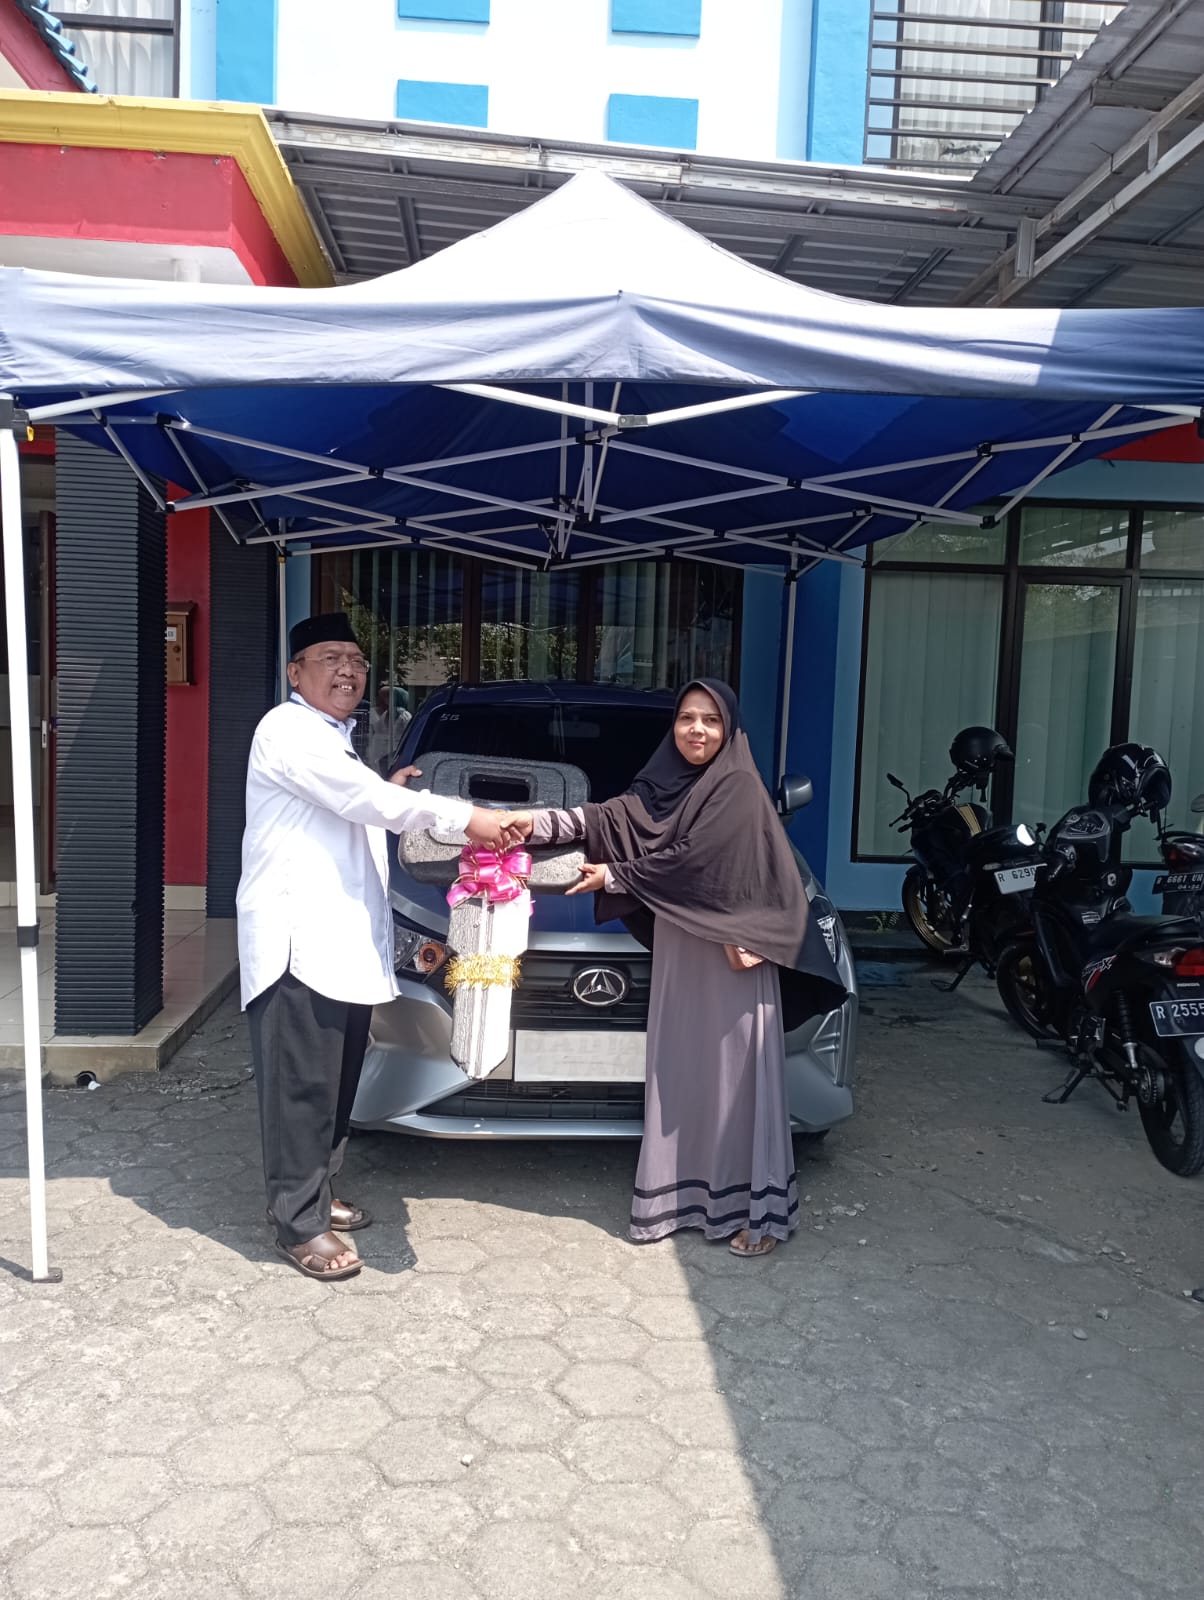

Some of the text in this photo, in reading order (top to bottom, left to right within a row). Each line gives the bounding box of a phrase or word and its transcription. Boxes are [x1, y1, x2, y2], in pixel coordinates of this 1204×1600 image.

[997, 872, 1005, 882] R
[1155, 1002, 1204, 1019] R 2555
